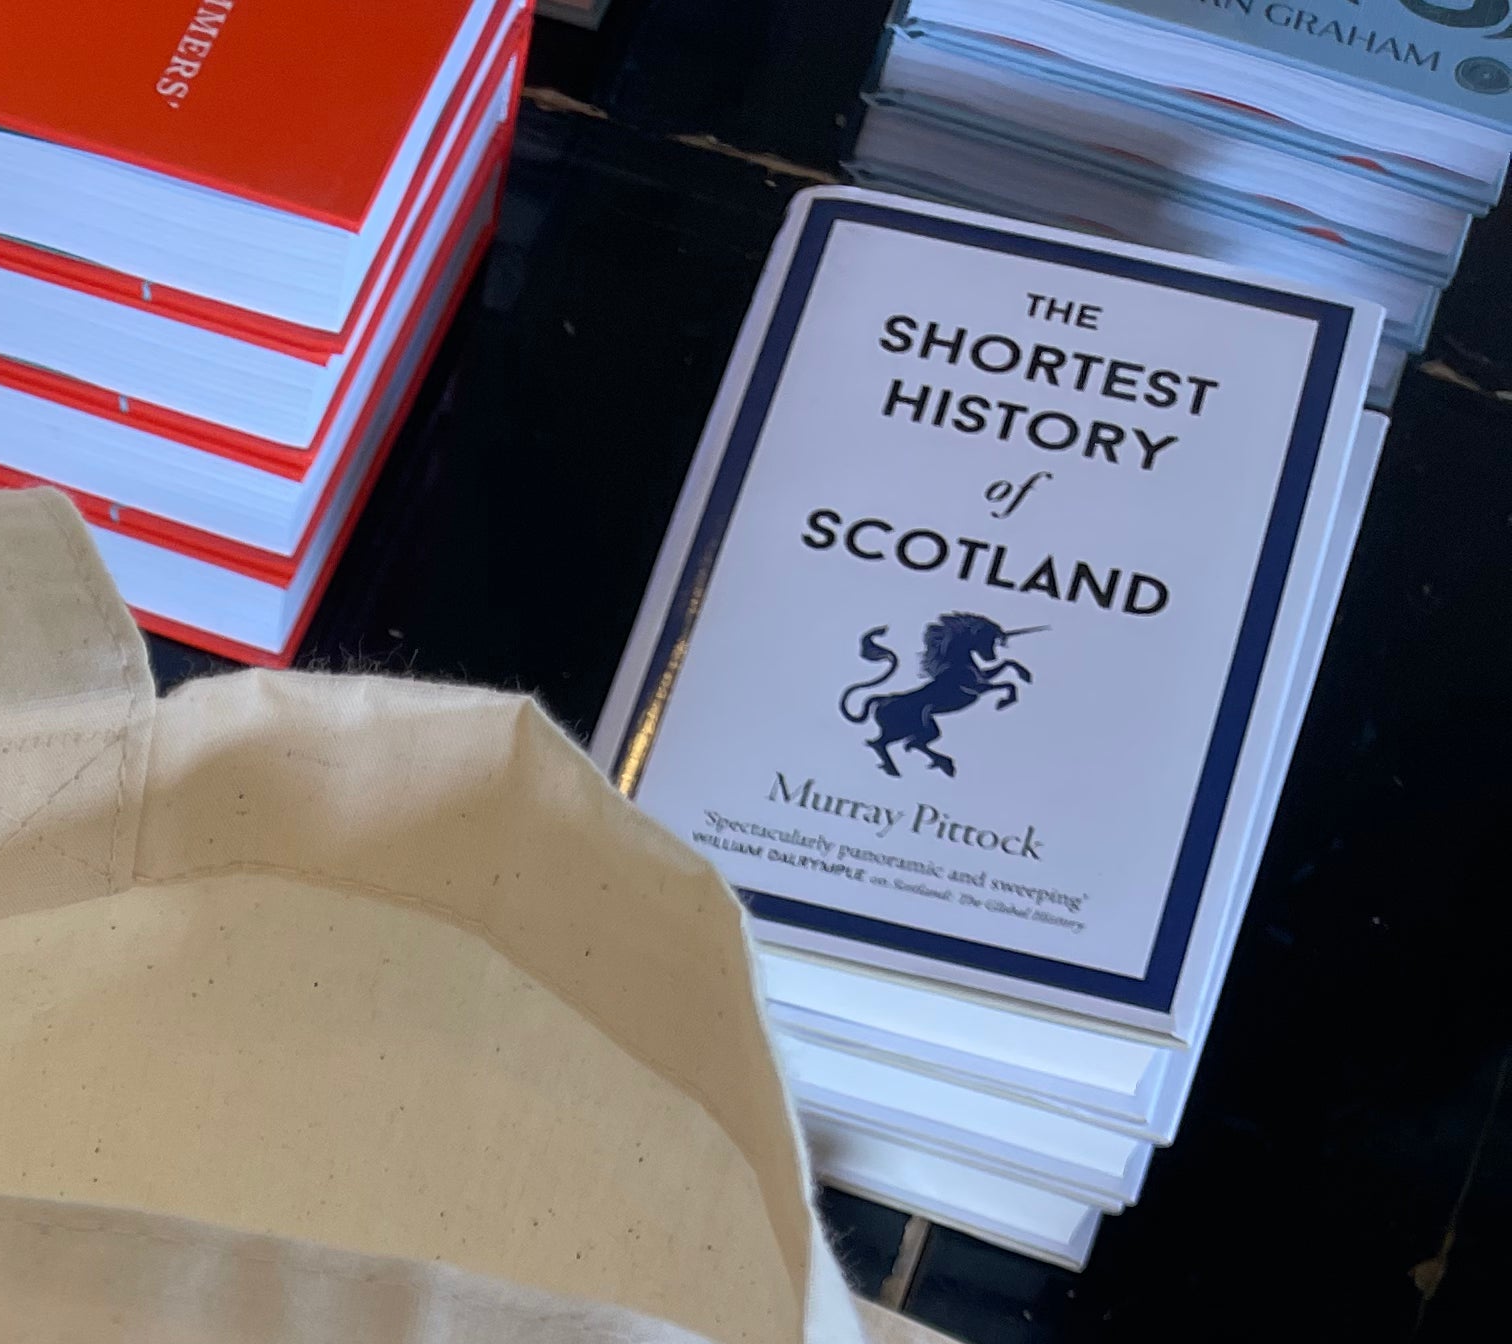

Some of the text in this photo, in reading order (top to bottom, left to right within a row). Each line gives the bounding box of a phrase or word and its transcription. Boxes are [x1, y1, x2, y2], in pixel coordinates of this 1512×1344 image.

[1264, 3, 1441, 72] GRAHAM
[1026, 292, 1103, 331] THE
[879, 314, 1219, 416] SHORTEST
[882, 379, 1178, 471] HISTORY
[985, 471, 1052, 518] of
[801, 509, 1169, 617] SCOTLAND
[767, 771, 1044, 861] Murray Pittock
[691, 831, 763, 860] WILLIAM
[767, 848, 866, 883] DALRYMPLE
[837, 843, 944, 880] panoramic
[947, 867, 986, 890] and
